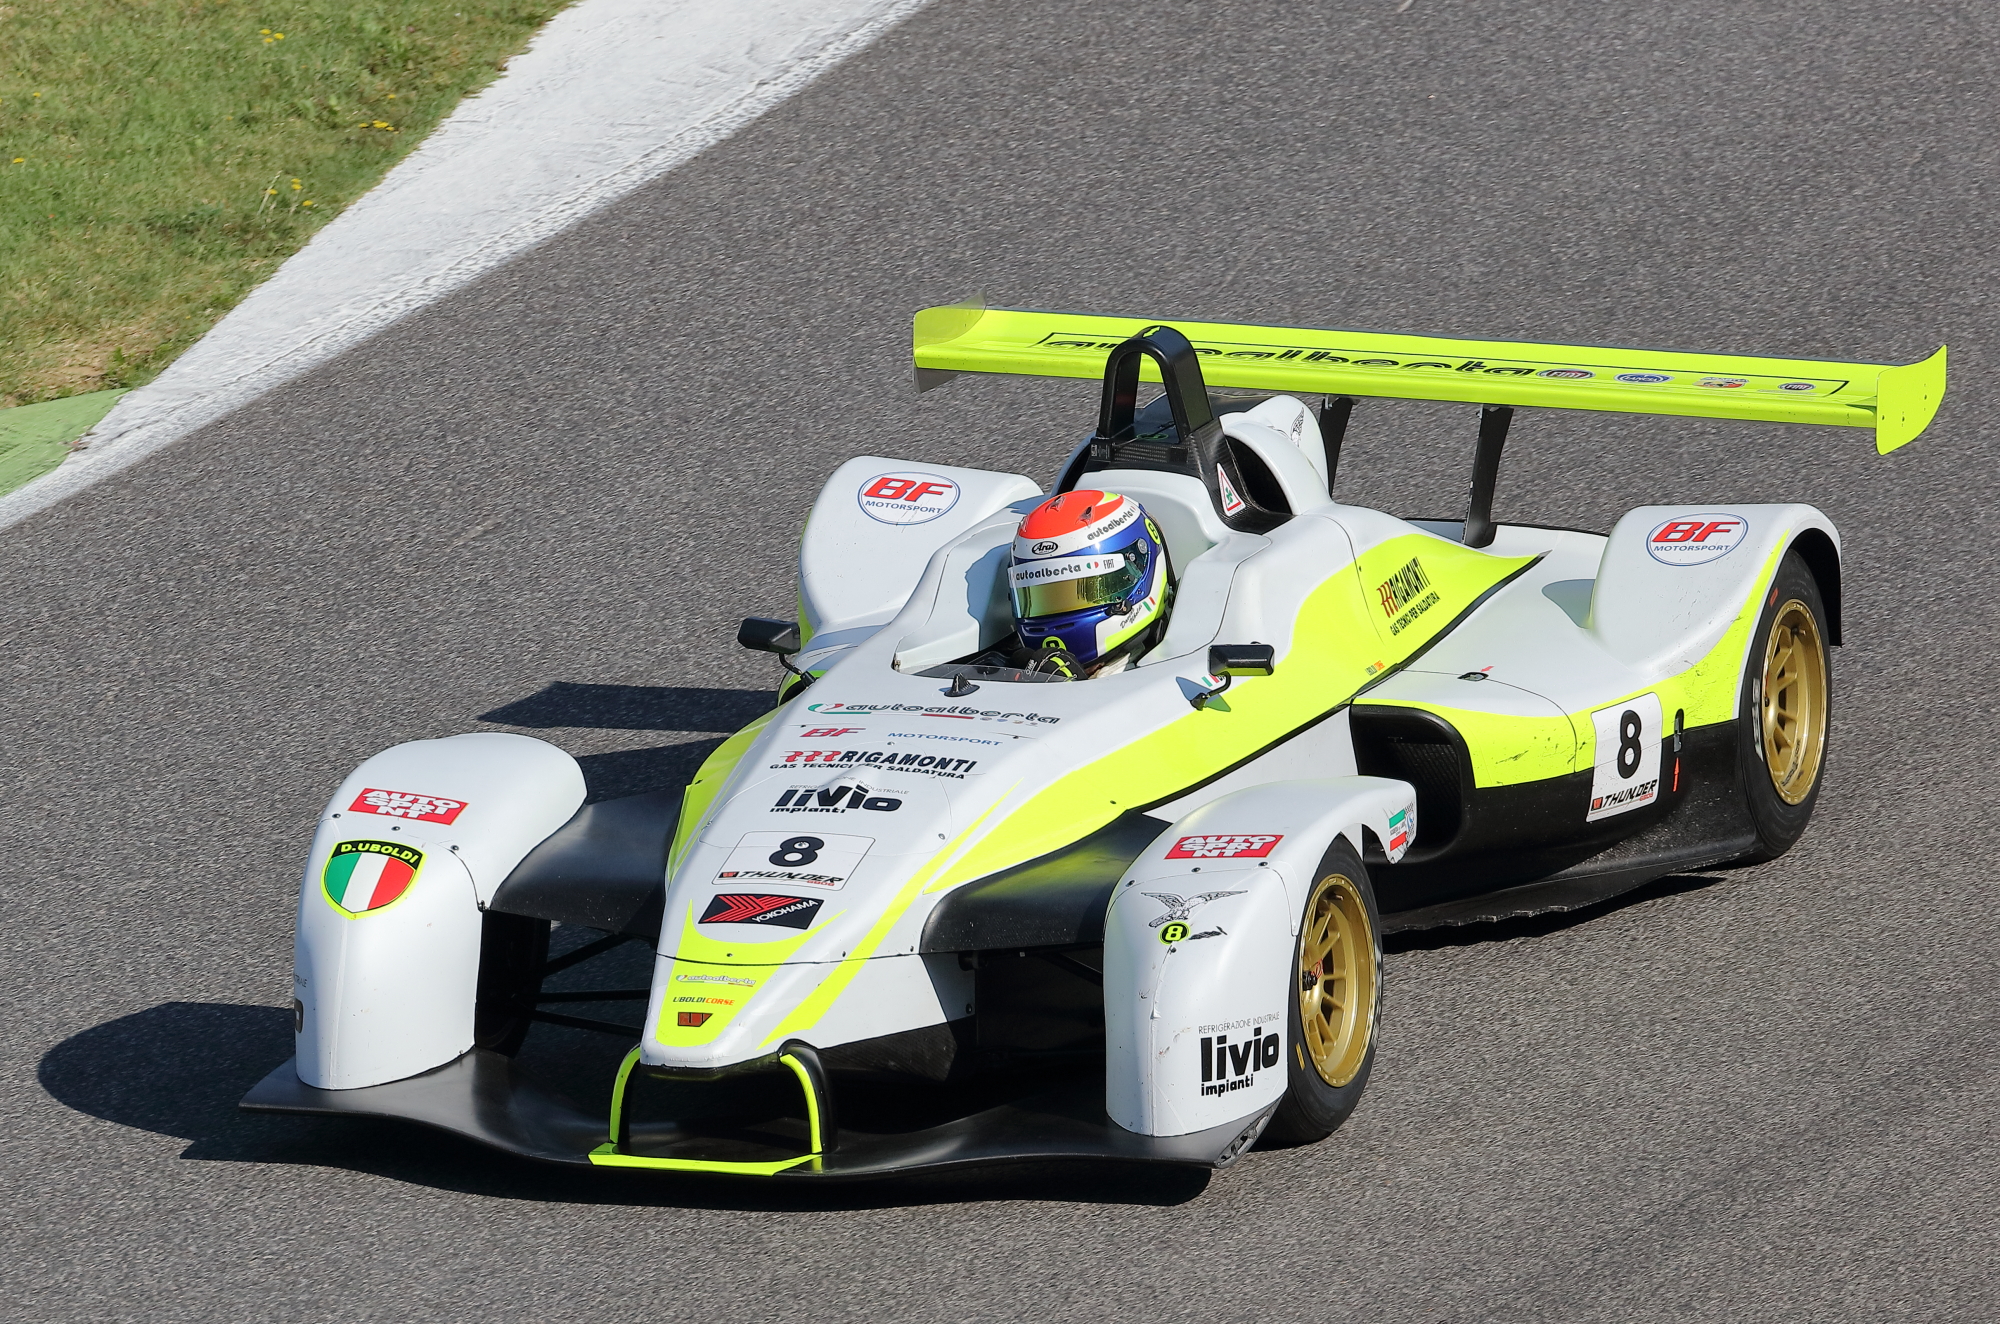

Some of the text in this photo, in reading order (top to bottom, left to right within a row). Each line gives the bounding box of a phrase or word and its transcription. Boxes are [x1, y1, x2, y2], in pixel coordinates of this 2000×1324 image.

[863, 477, 953, 502] BF
[865, 500, 943, 514] MOTORSPORT
[1086, 508, 1134, 541] autoalberta
[1652, 521, 1741, 543] BF
[1033, 541, 1056, 552] Arai
[1016, 564, 1082, 581] autoalberta
[1103, 559, 1115, 569] FIAT
[845, 703, 1061, 725] autoalberta
[800, 727, 1004, 746] BF MOTORSPORT
[1617, 709, 1642, 779] 8
[838, 750, 978, 774] RIGAMONTI
[885, 765, 965, 779] SALDATURA
[362, 790, 461, 809] AUTO
[774, 784, 903, 812] livio
[1602, 779, 1658, 808] THUNDER
[363, 797, 449, 815] SPRI
[376, 805, 427, 818] NT
[769, 806, 847, 814] impianti
[1179, 842, 1265, 851] SPRI
[1180, 835, 1277, 845] AUTO
[340, 842, 420, 864] D.UBOLDI
[769, 836, 825, 867] 8
[1191, 848, 1242, 857] NT
[738, 871, 844, 884] THUNDER
[752, 900, 819, 923] YOKOHAMA
[1165, 925, 1184, 941] 8
[687, 974, 757, 986] autoalberta
[1198, 1011, 1280, 1035] REFRIGERAZIONE INDUSTRIALE
[1200, 1026, 1280, 1083] livio
[1201, 1073, 1254, 1098] impianti
